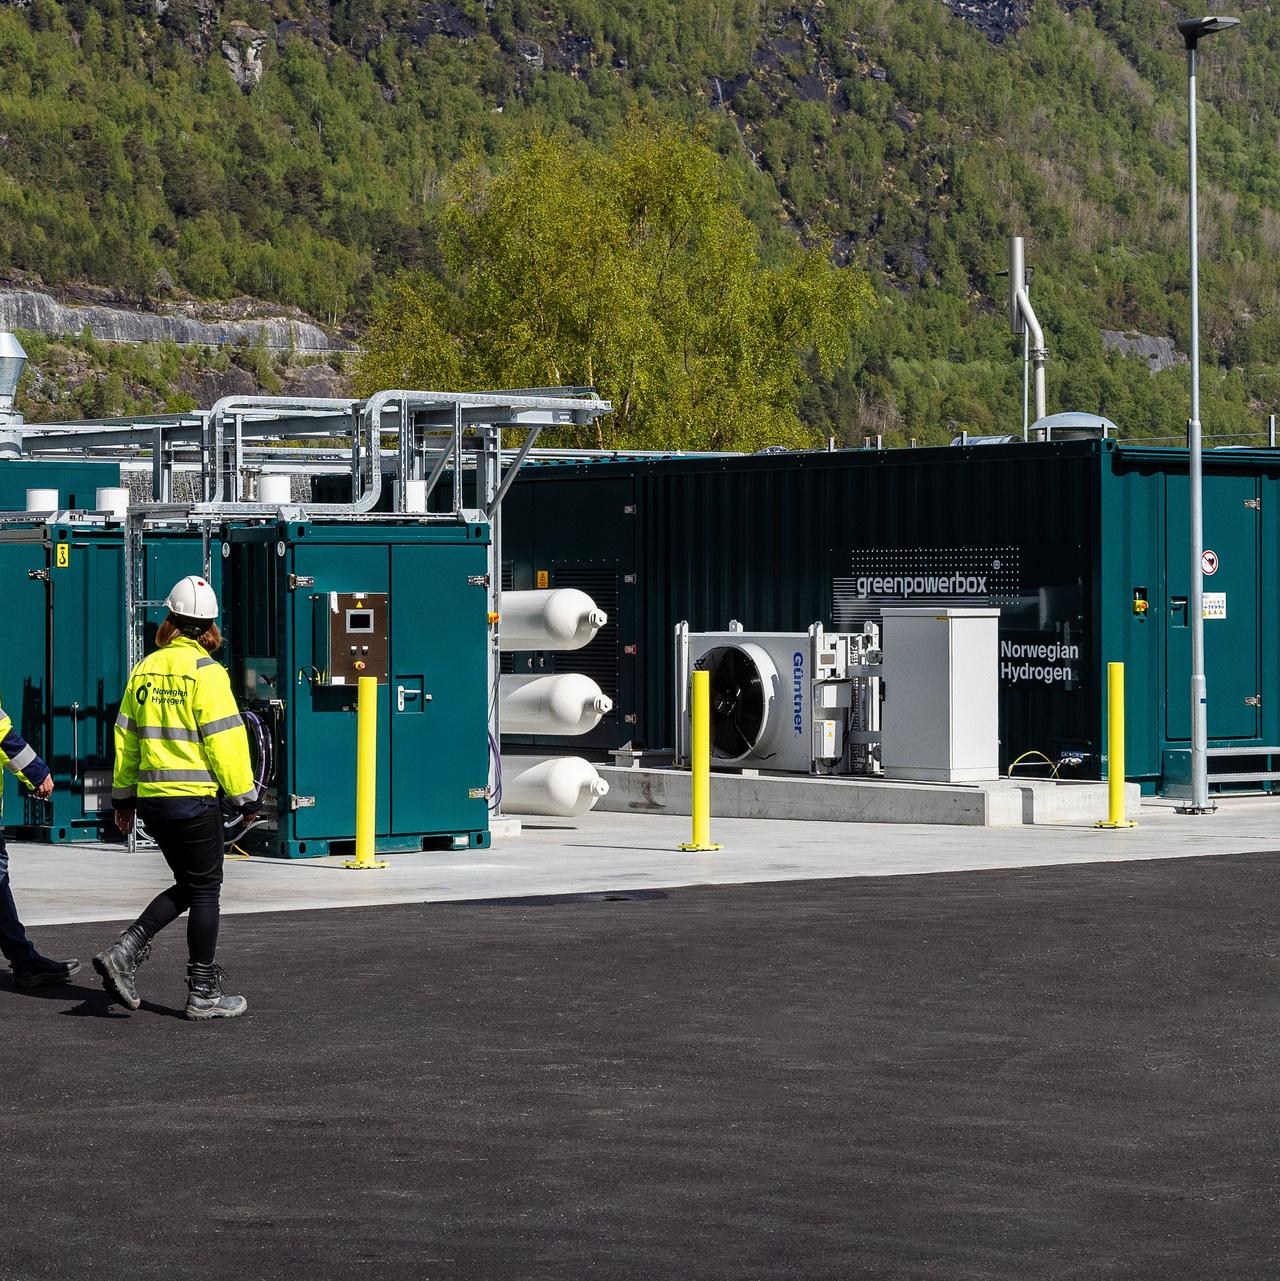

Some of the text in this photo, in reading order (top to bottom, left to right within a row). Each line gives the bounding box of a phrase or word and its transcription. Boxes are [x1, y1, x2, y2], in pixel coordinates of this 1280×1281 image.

[857, 571, 987, 598] greenpowerbox
[1001, 640, 1079, 662] Norwegian
[1001, 662, 1072, 684] Hydrogen
[793, 652, 804, 734] Güntner
